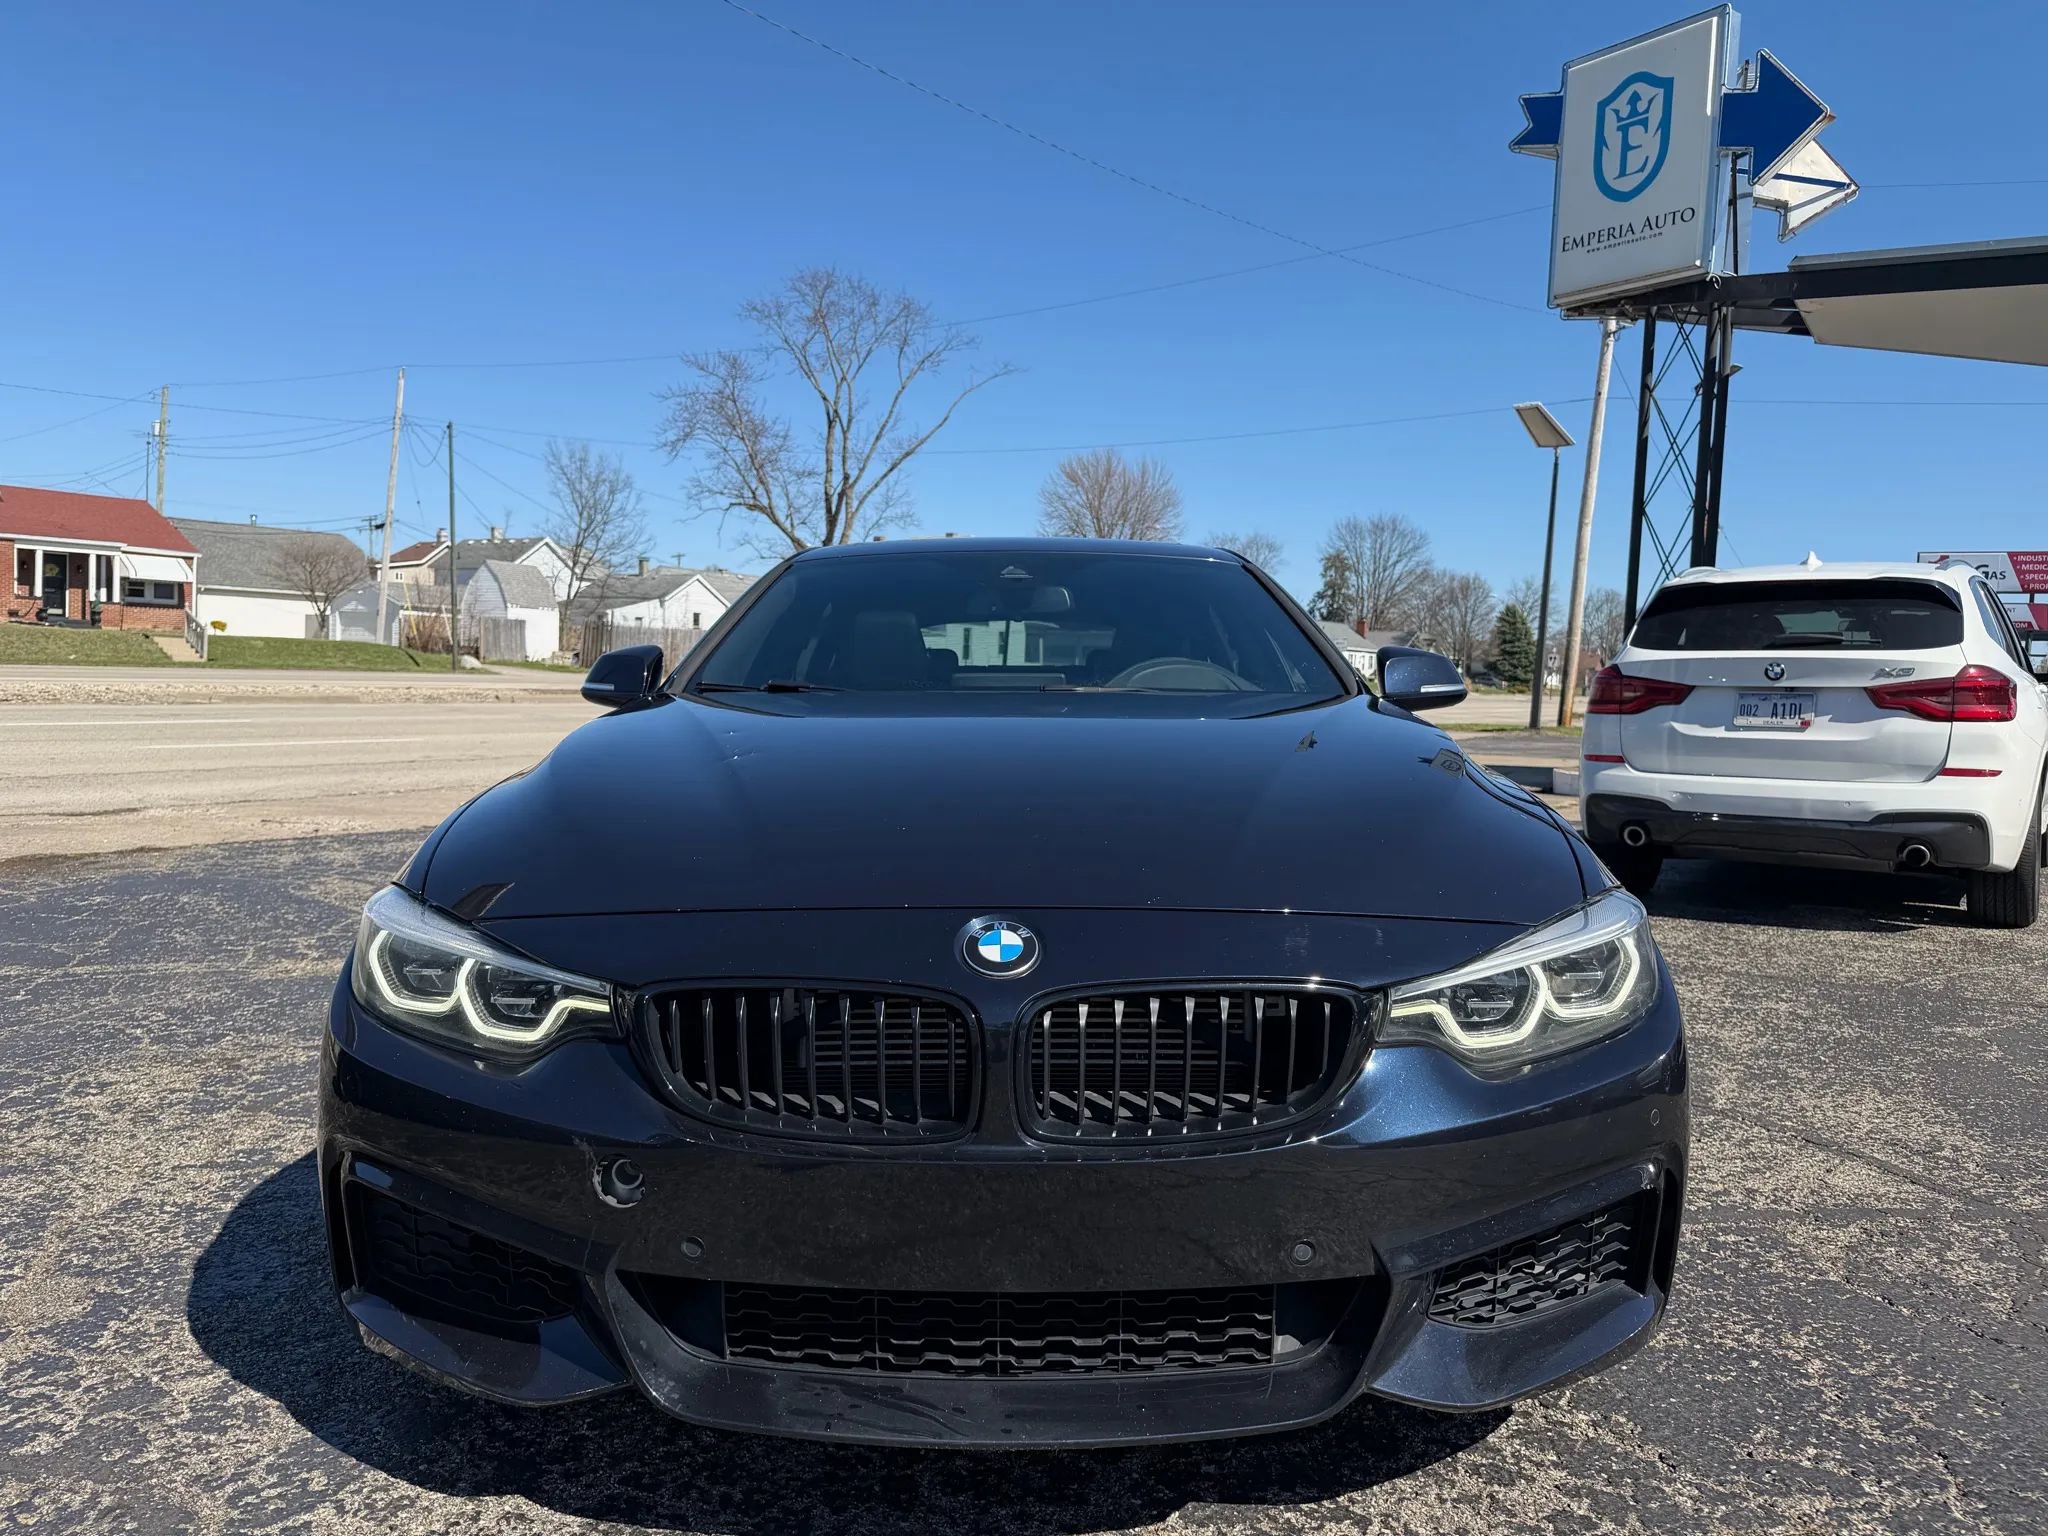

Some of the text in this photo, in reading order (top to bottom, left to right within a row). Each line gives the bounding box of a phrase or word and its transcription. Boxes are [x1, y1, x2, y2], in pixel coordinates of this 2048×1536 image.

[1561, 206, 1696, 253] EMPERIA AUTO
[2021, 563, 2048, 571] MEDIC
[1740, 703, 1759, 717] 002
[972, 921, 1031, 939] BMW
